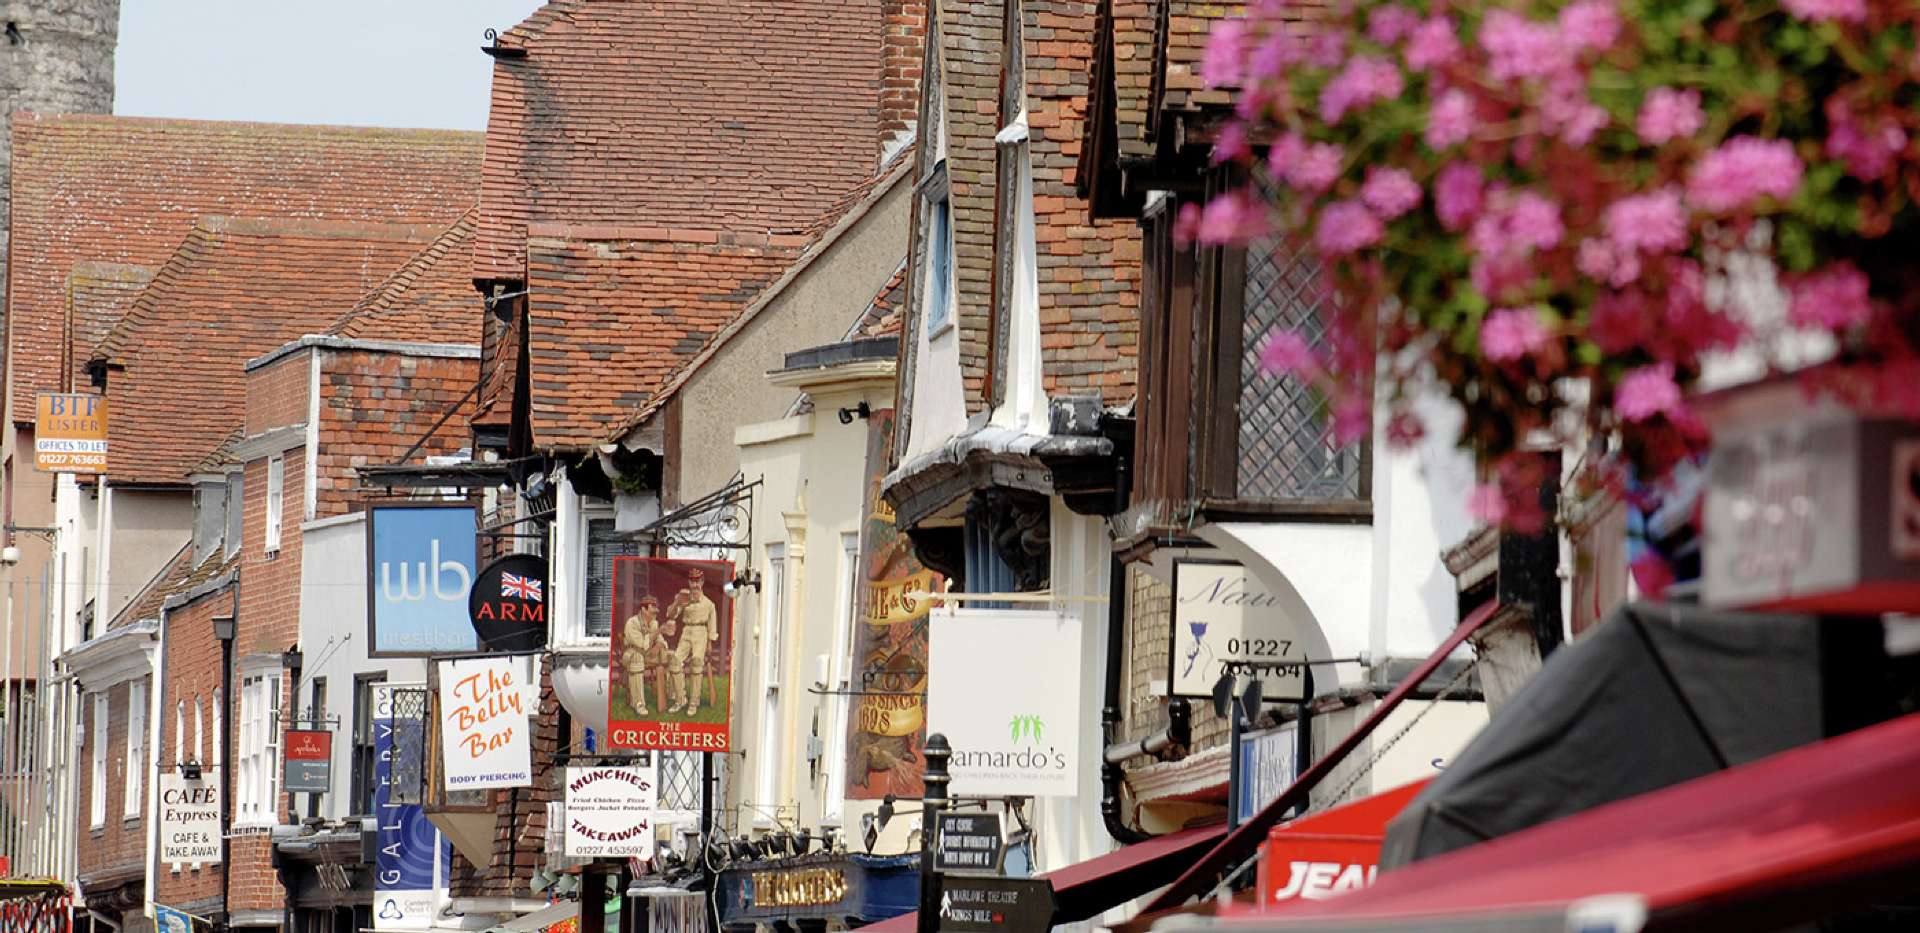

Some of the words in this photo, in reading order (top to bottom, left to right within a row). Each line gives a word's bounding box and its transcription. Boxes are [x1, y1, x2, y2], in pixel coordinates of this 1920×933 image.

[48, 419, 98, 432] LISTER
[38, 440, 74, 452] OFFICES
[77, 441, 89, 452] TO
[91, 442, 107, 453] LET
[39, 454, 67, 465] 01227
[381, 539, 471, 603] wb
[476, 601, 545, 622] ARM
[1227, 638, 1293, 656] 01227
[453, 669, 513, 703] The
[447, 690, 523, 732] Belly
[659, 722, 681, 732] THE
[458, 727, 513, 758] Bar
[612, 729, 727, 748] CRICKETERS
[449, 776, 477, 784] BODY
[480, 772, 526, 782] PIERCING
[570, 769, 651, 792] MUNCHIES
[163, 784, 217, 804] CAFÉ
[165, 808, 218, 824] Express
[172, 832, 199, 843] CAFE
[201, 832, 209, 843] &
[571, 818, 649, 842] TAKEAWAY
[165, 846, 189, 857] TAKE
[190, 846, 218, 857] AWAY
[575, 846, 604, 855] 01227
[607, 846, 643, 855] 453597
[952, 889, 985, 903] MARLOWE
[987, 891, 1018, 904] THEATRE
[951, 909, 973, 921] KINGS
[973, 909, 992, 922] MILE
